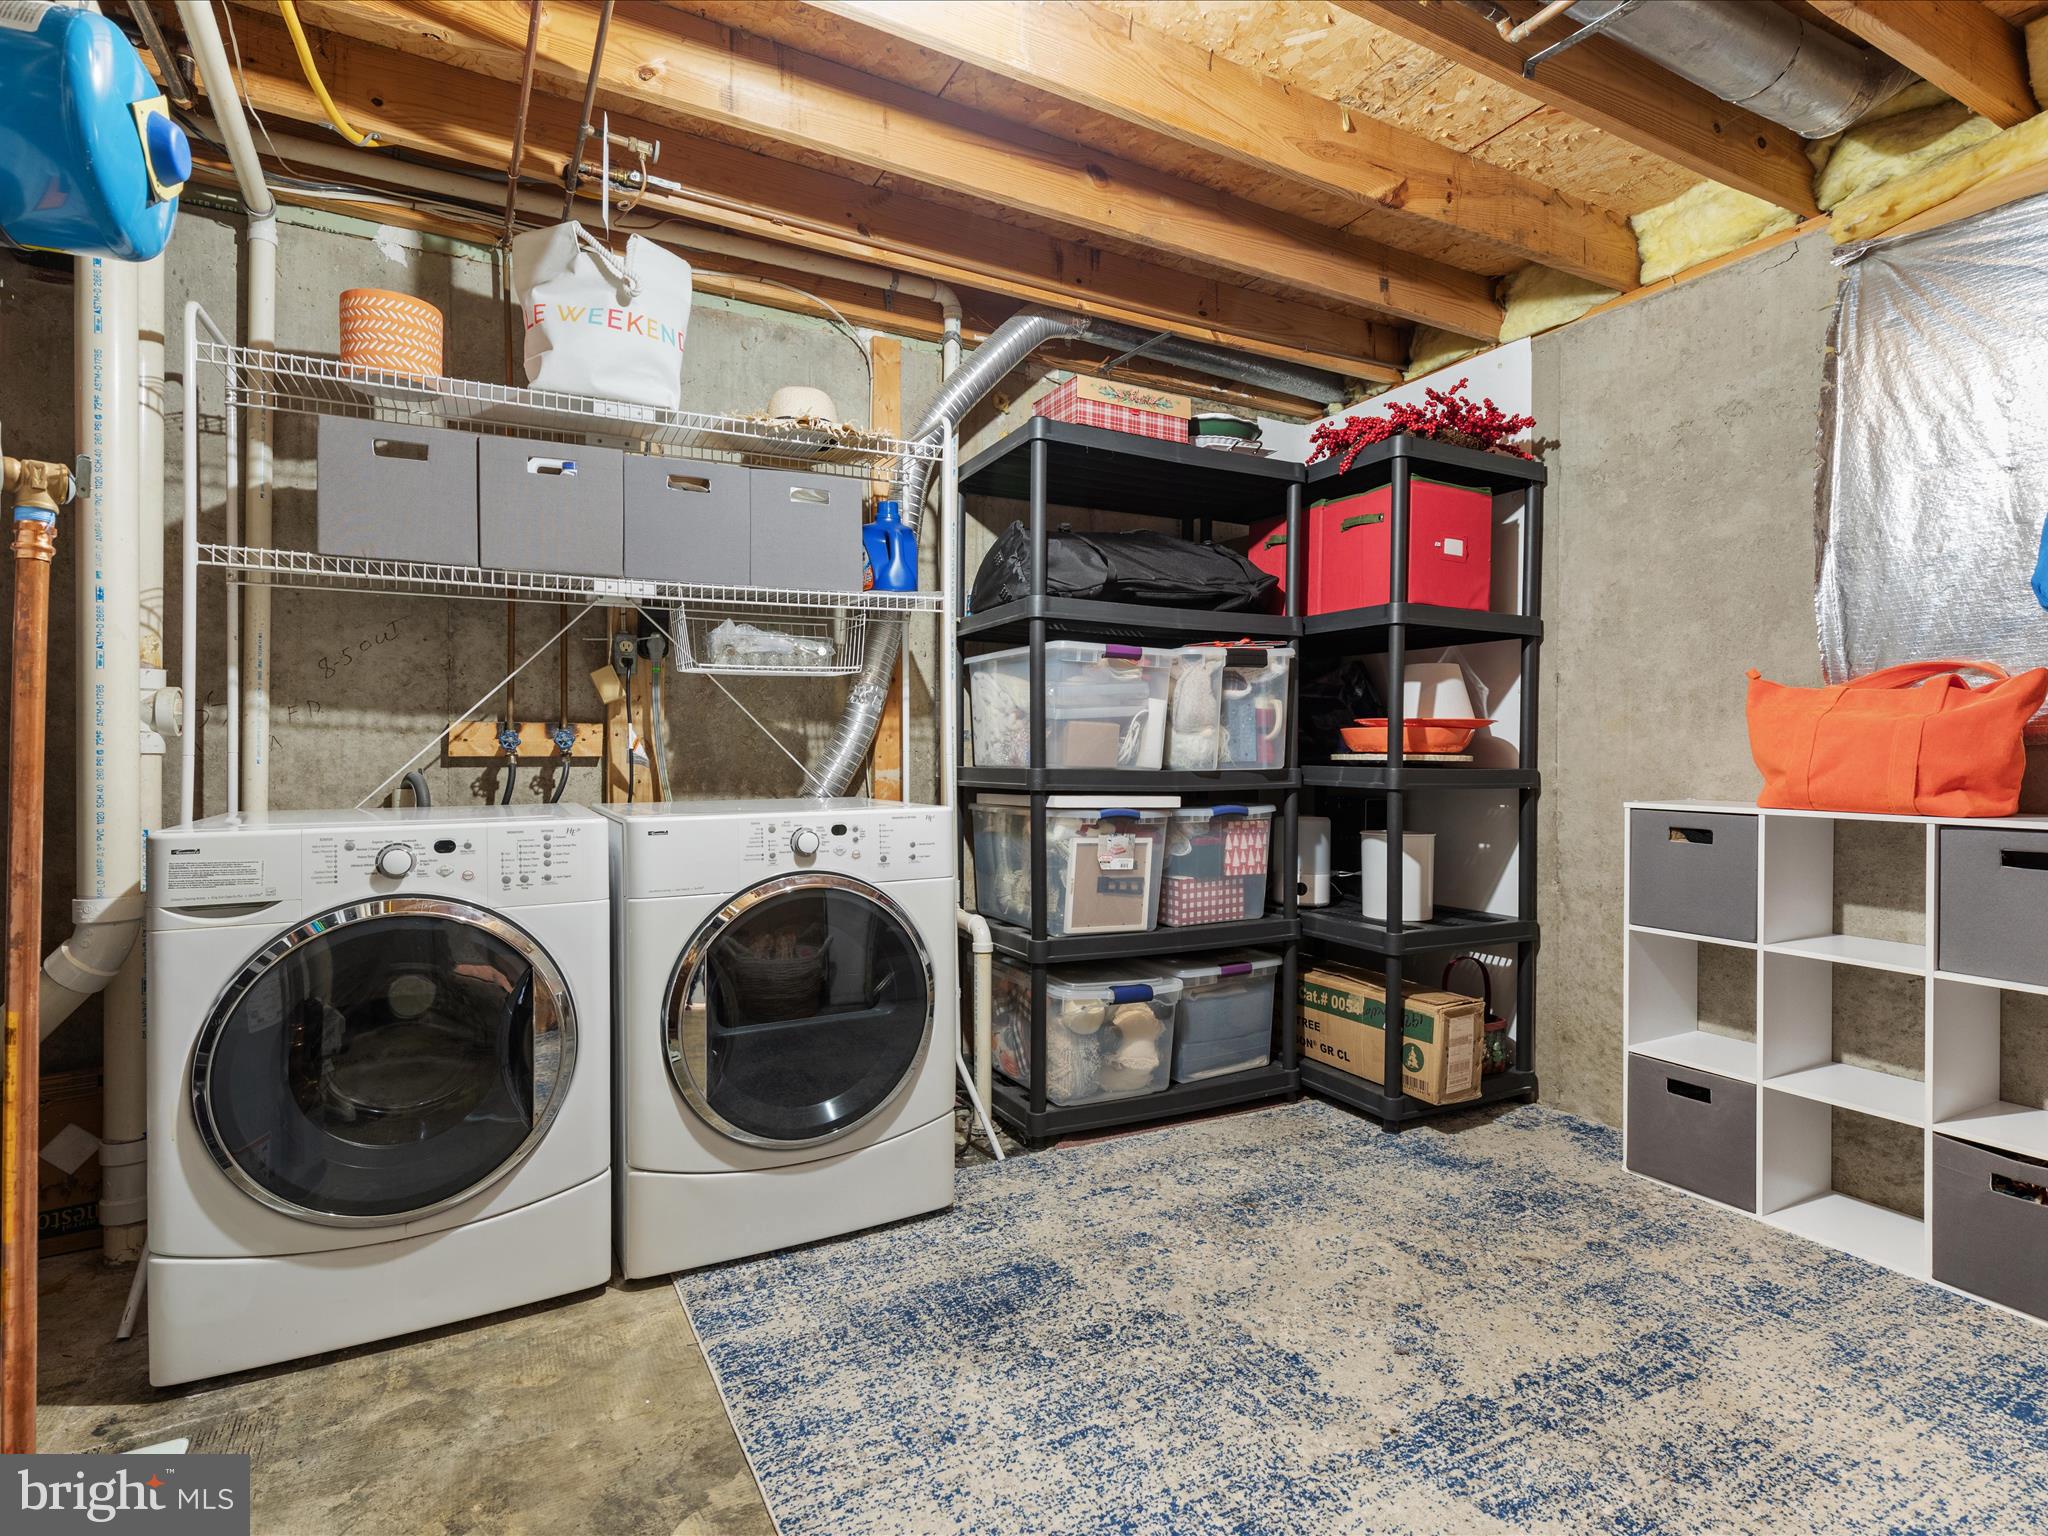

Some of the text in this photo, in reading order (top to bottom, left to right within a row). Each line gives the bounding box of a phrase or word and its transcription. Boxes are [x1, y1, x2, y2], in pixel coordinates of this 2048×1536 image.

[525, 303, 546, 330] LE
[1320, 1043, 1335, 1057] GR
[1337, 1049, 1351, 1062] CL
